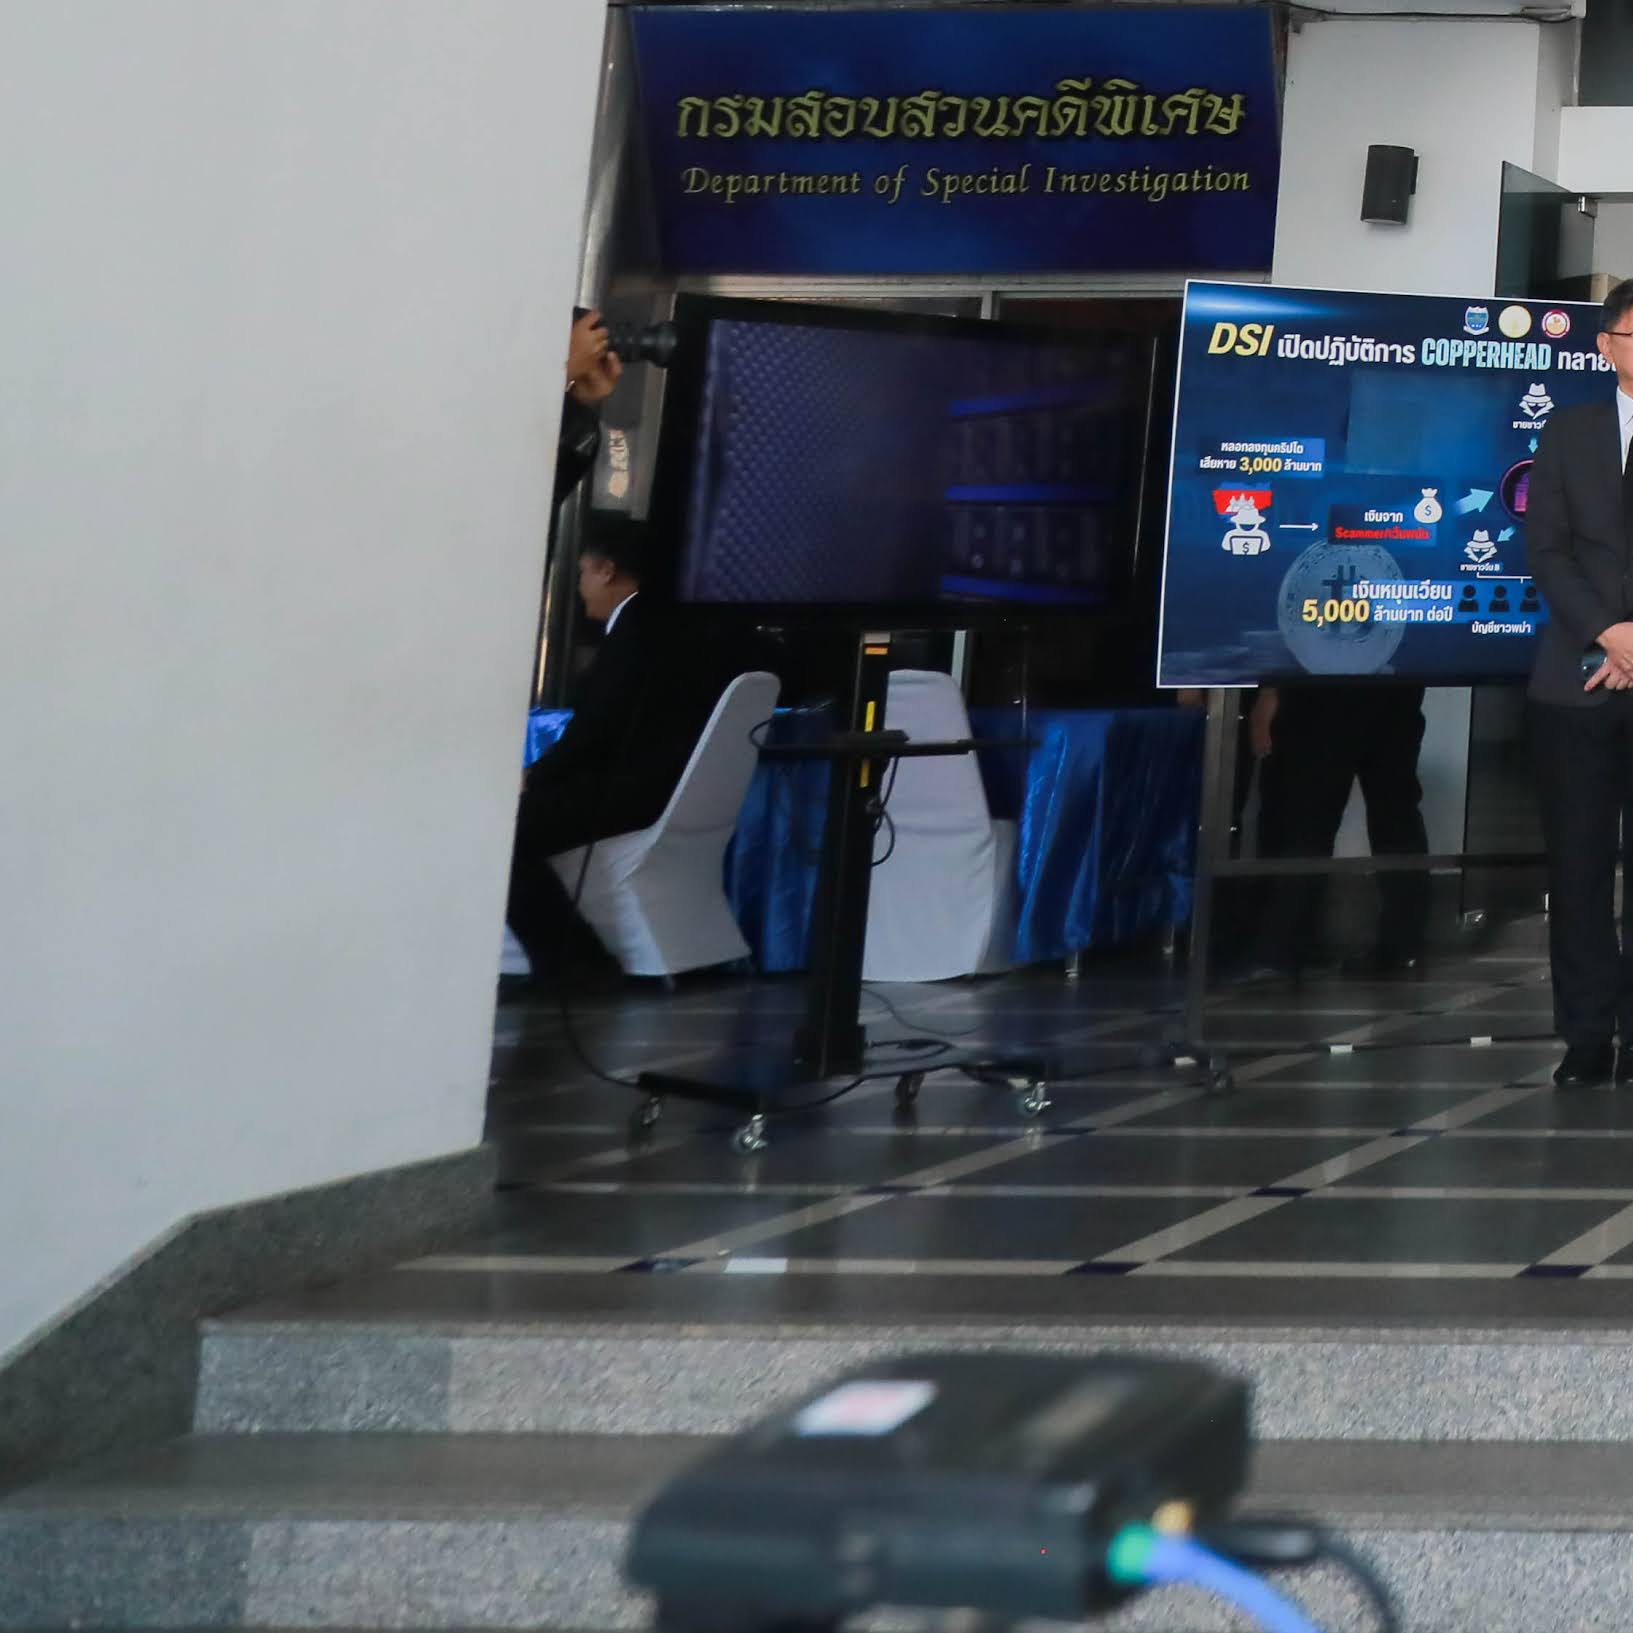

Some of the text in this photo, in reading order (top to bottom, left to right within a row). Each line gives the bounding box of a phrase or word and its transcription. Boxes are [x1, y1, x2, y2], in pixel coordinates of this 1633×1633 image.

[675, 78, 1247, 138] กรมสอบสวนคดีพิเศษ
[681, 163, 1251, 204] Department of Special Investigation
[1207, 321, 1275, 357] DSI
[1277, 333, 1416, 366] เปิดปฏิบัติการ
[1421, 337, 1551, 371] COPPERHEAD
[1239, 456, 1282, 475] 3,000
[1352, 579, 1453, 605] เงินหมุนเวียน
[1301, 598, 1371, 628] 5,000
[1373, 604, 1424, 622] ล้านบาท
